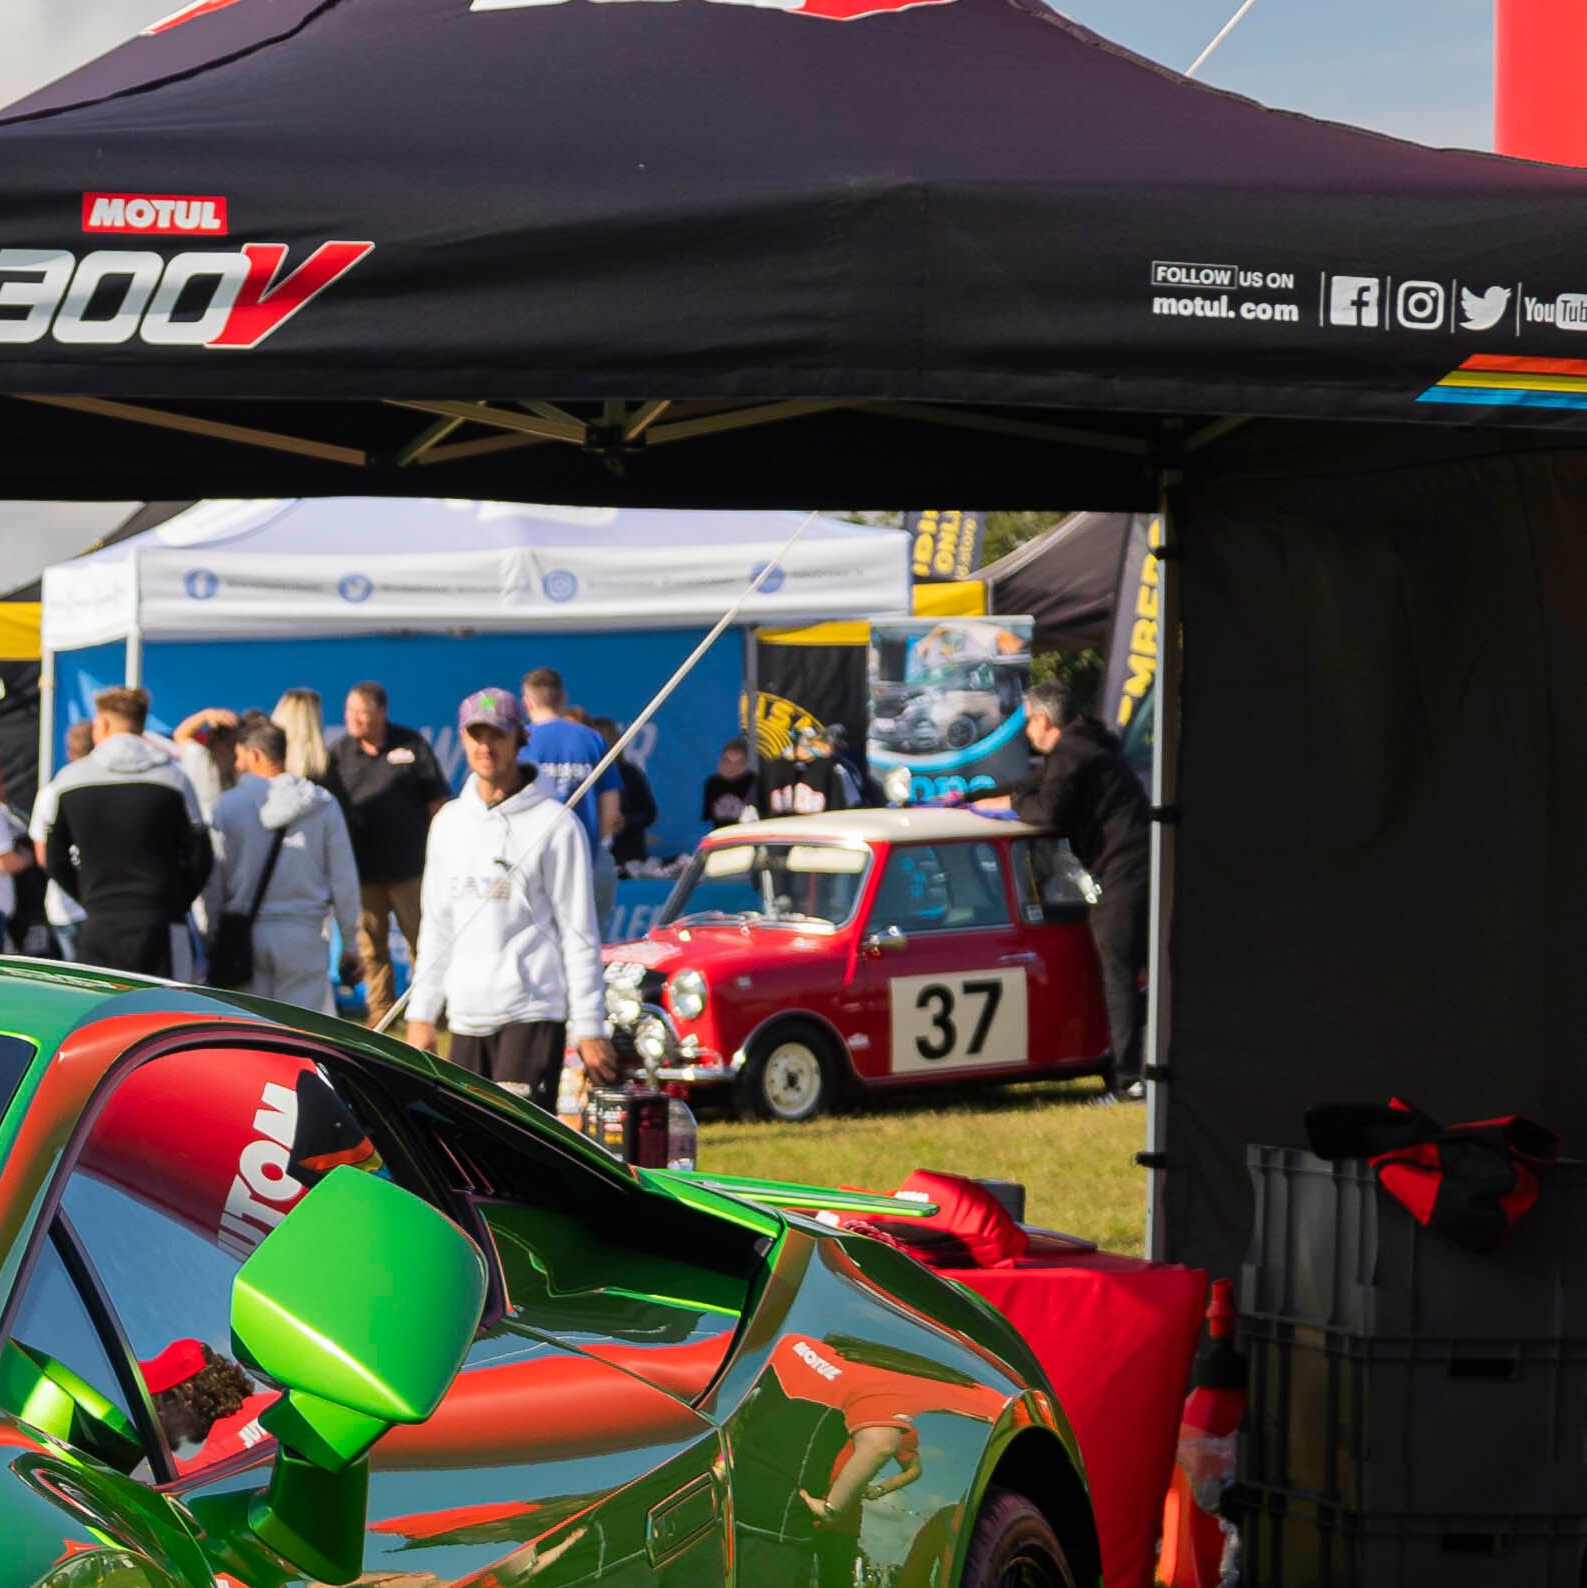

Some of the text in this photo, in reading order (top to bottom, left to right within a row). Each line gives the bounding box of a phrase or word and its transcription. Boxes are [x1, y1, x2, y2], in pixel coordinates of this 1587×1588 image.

[88, 197, 222, 230] MOTUL
[1155, 264, 1295, 290] FOLLOW US ON
[915, 979, 1003, 1060] 37
